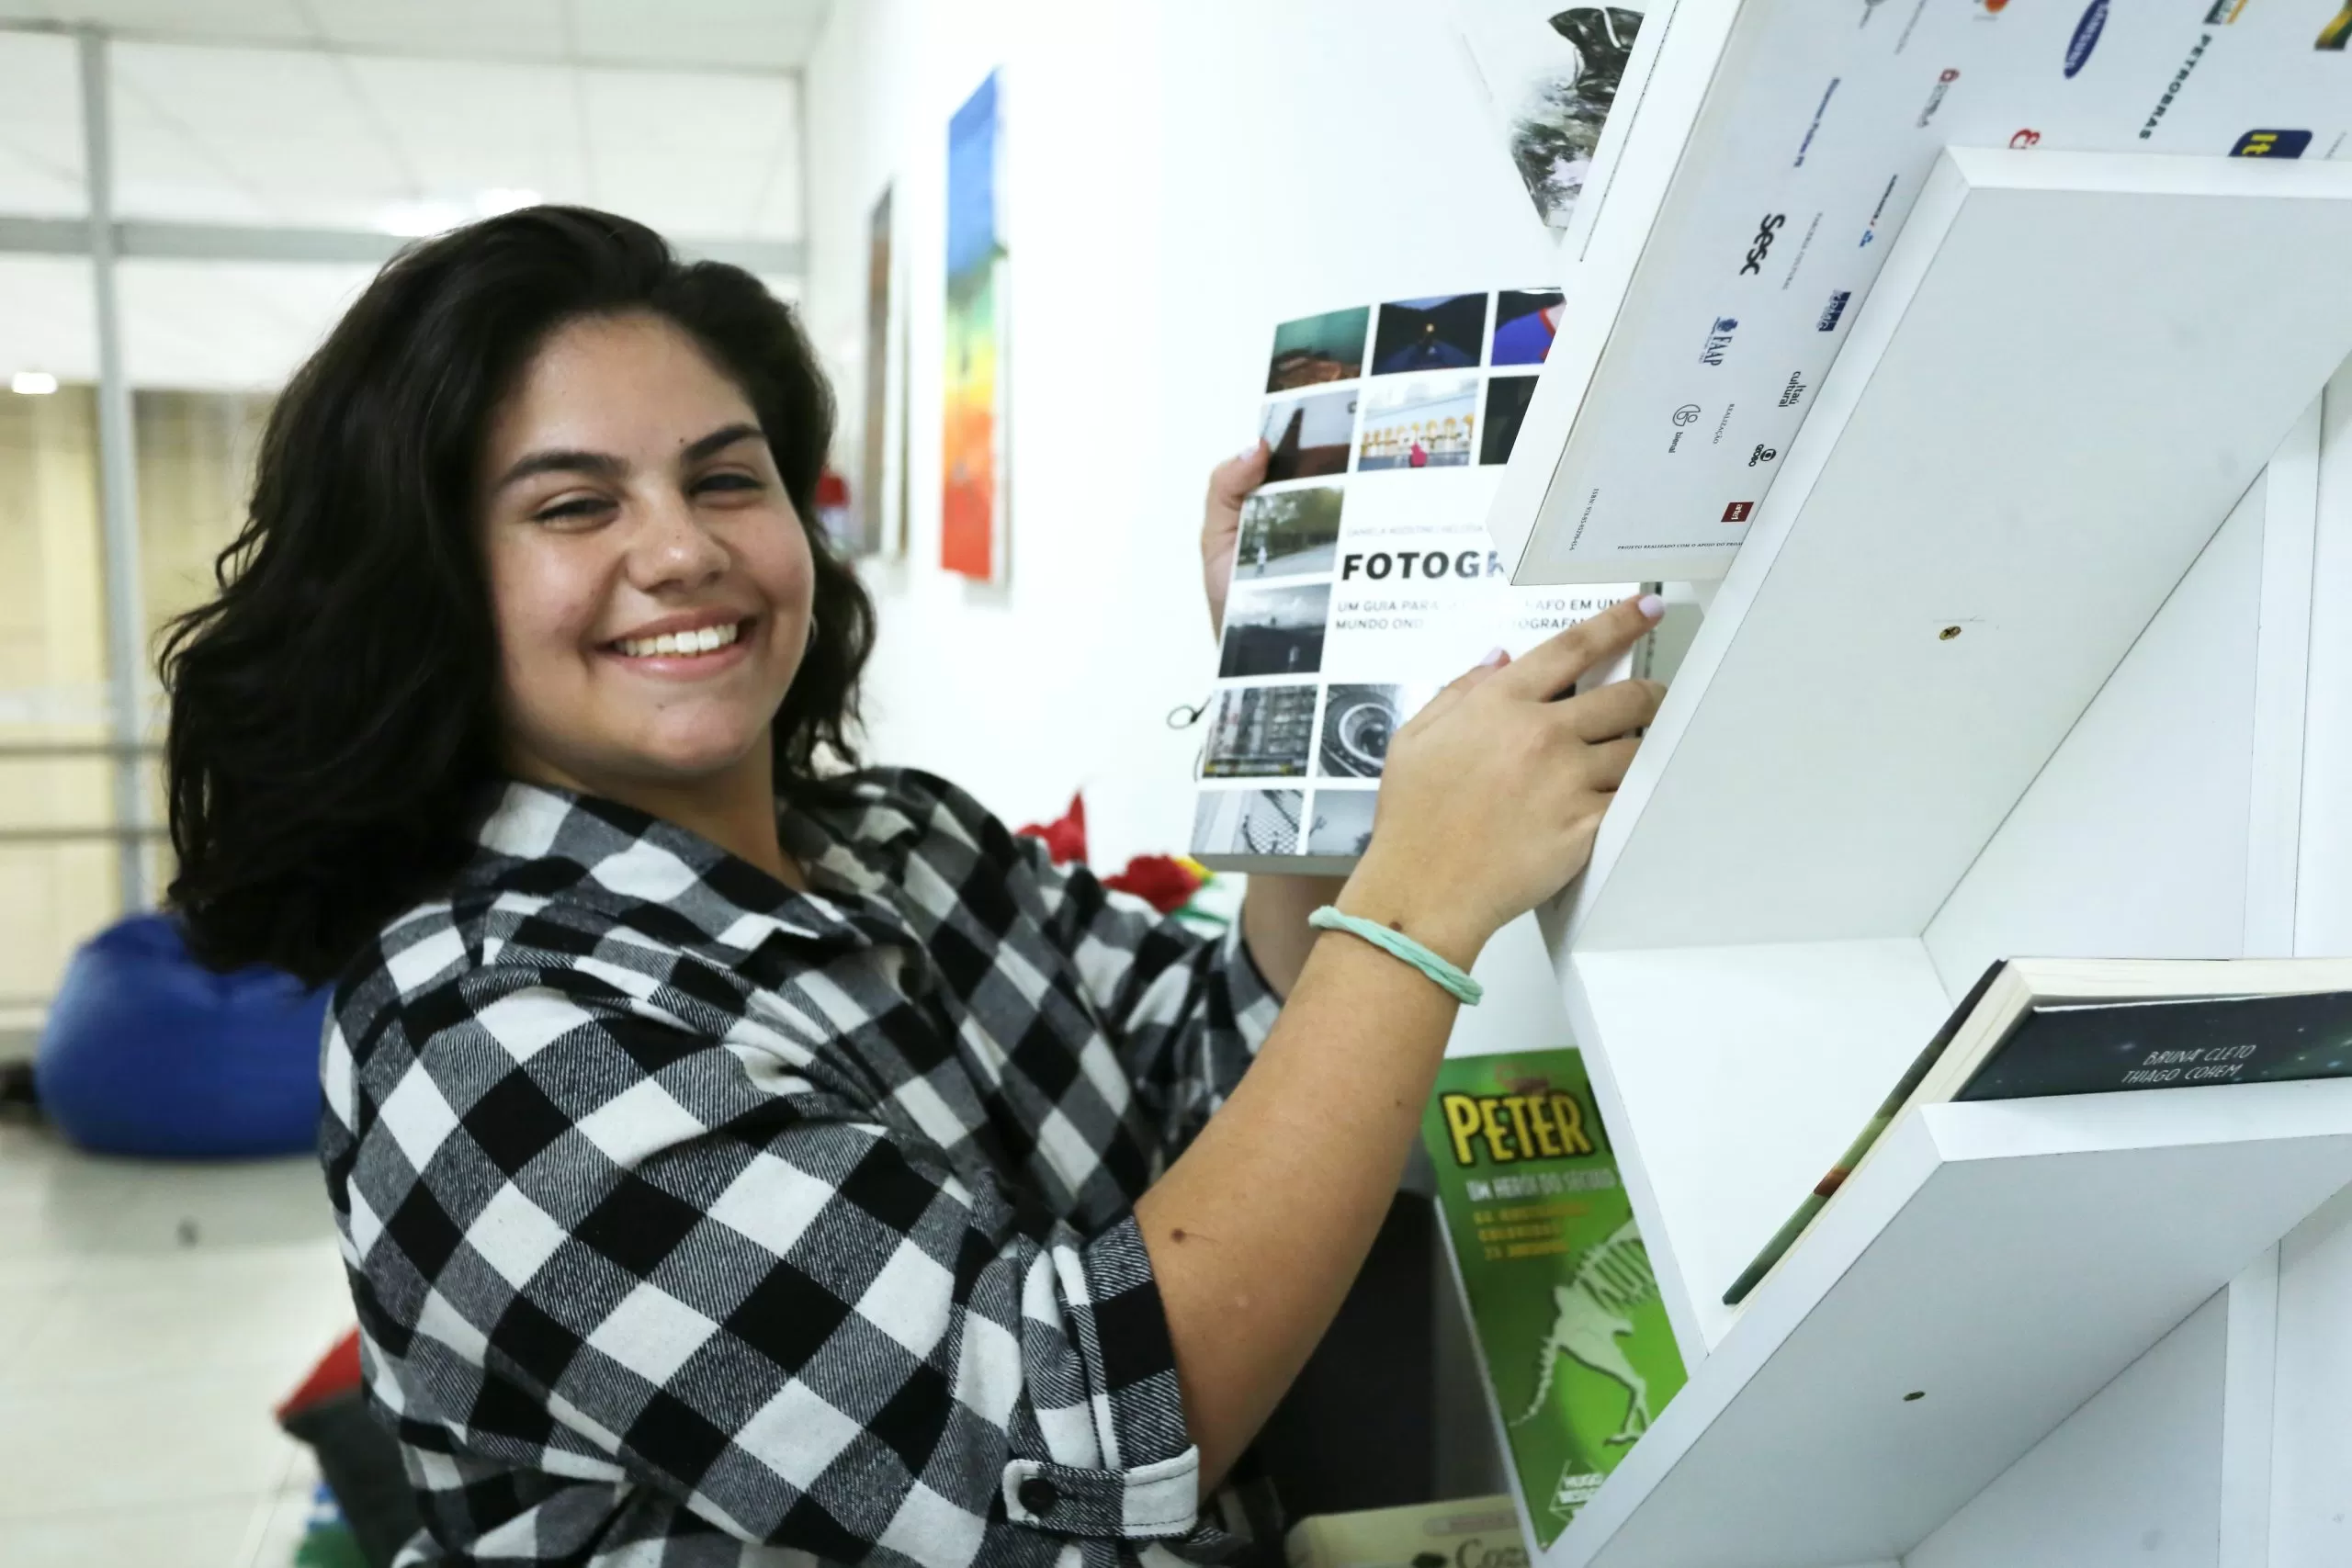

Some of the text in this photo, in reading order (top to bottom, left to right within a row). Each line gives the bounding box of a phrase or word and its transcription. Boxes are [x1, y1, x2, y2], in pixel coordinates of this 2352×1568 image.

[2138, 33, 2212, 140] PETROBRAS
[2242, 133, 2278, 156] It
[1739, 213, 1786, 276] Sesc
[1702, 336, 1733, 367] FAAP
[1778, 371, 1802, 407] cultural
[1788, 385, 1807, 405] Itaú
[1668, 431, 1684, 454] bienal
[1341, 550, 1505, 581] FOTOGR
[1337, 601, 1359, 613] UM
[1363, 600, 1397, 612] GUIA
[1570, 599, 1592, 611] EM
[1335, 617, 1424, 631] MUNDO OND
[2142, 1044, 2257, 1066] BRUNA CLETO
[2120, 1068, 2181, 1084] THIAGO
[1442, 1092, 1593, 1165] PETER
